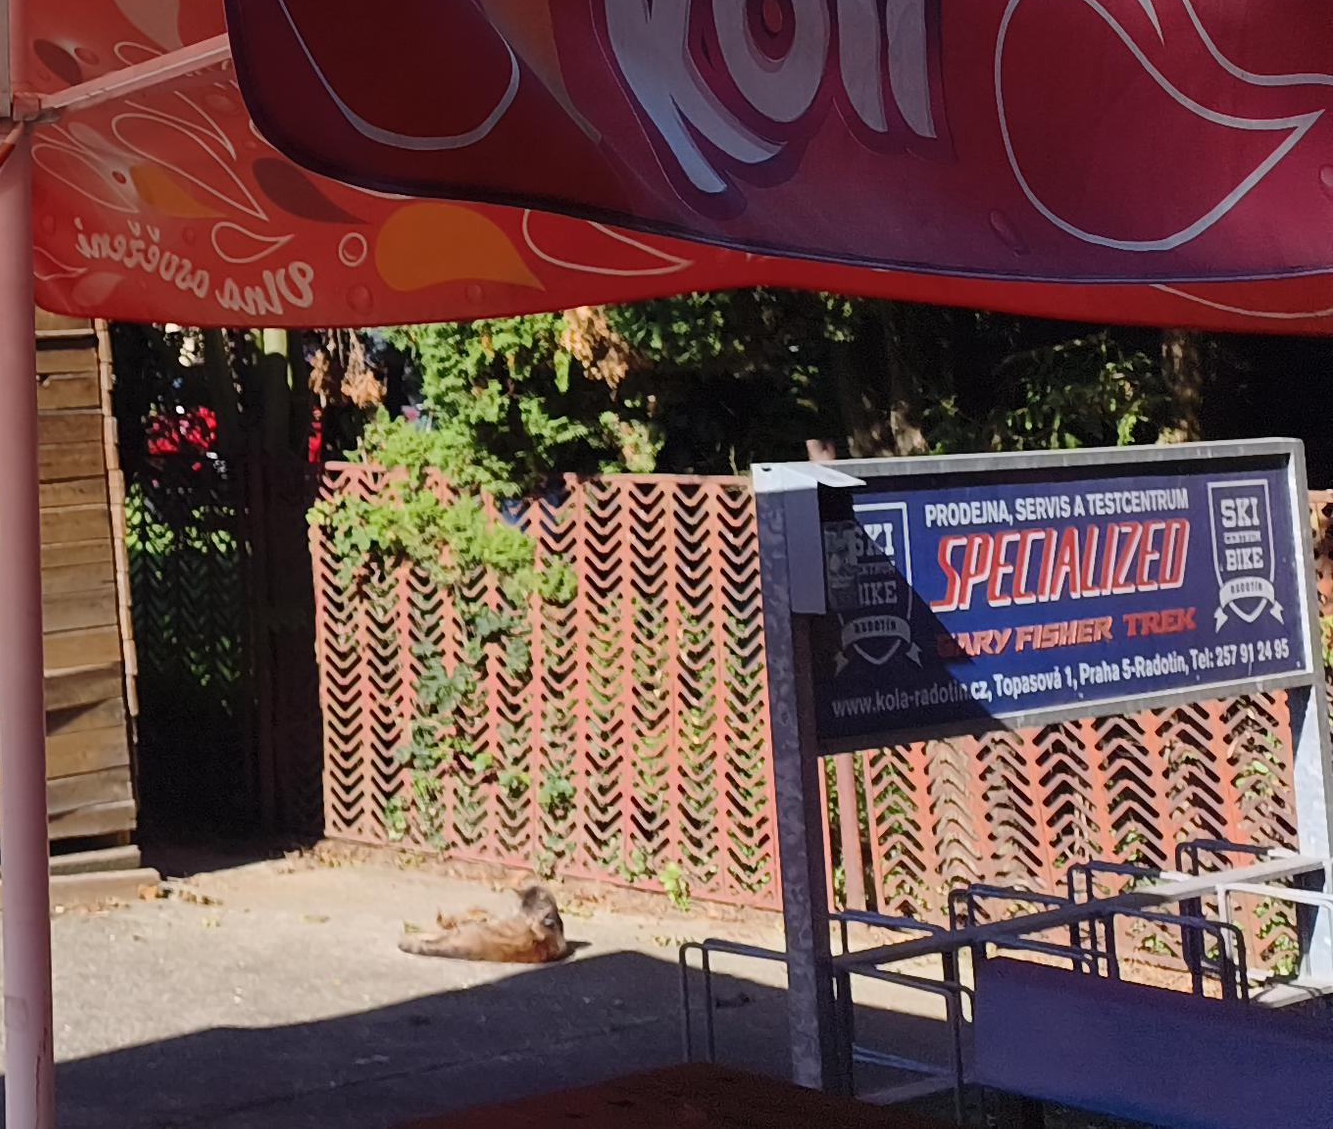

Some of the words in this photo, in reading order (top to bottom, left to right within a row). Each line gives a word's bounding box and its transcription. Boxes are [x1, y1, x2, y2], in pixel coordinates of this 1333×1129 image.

[924, 500, 1013, 527] PRODEJNA,
[1015, 495, 1071, 521] SERVIS
[1073, 494, 1085, 518] A
[1087, 488, 1189, 516] TESTCENTRUM
[1220, 496, 1261, 528] SKI
[929, 519, 1191, 613] SPECIALIZED
[1225, 546, 1264, 571] BIKE
[1015, 616, 1114, 652] FISHER
[1122, 607, 1198, 638] TREK
[993, 666, 1062, 700] Topasová
[1079, 659, 1121, 686] Praha
[1189, 647, 1214, 671] Tel:
[1215, 643, 1237, 666] 257
[1239, 642, 1255, 664] 91
[1257, 639, 1273, 661] 24
[1274, 637, 1290, 659] 95
